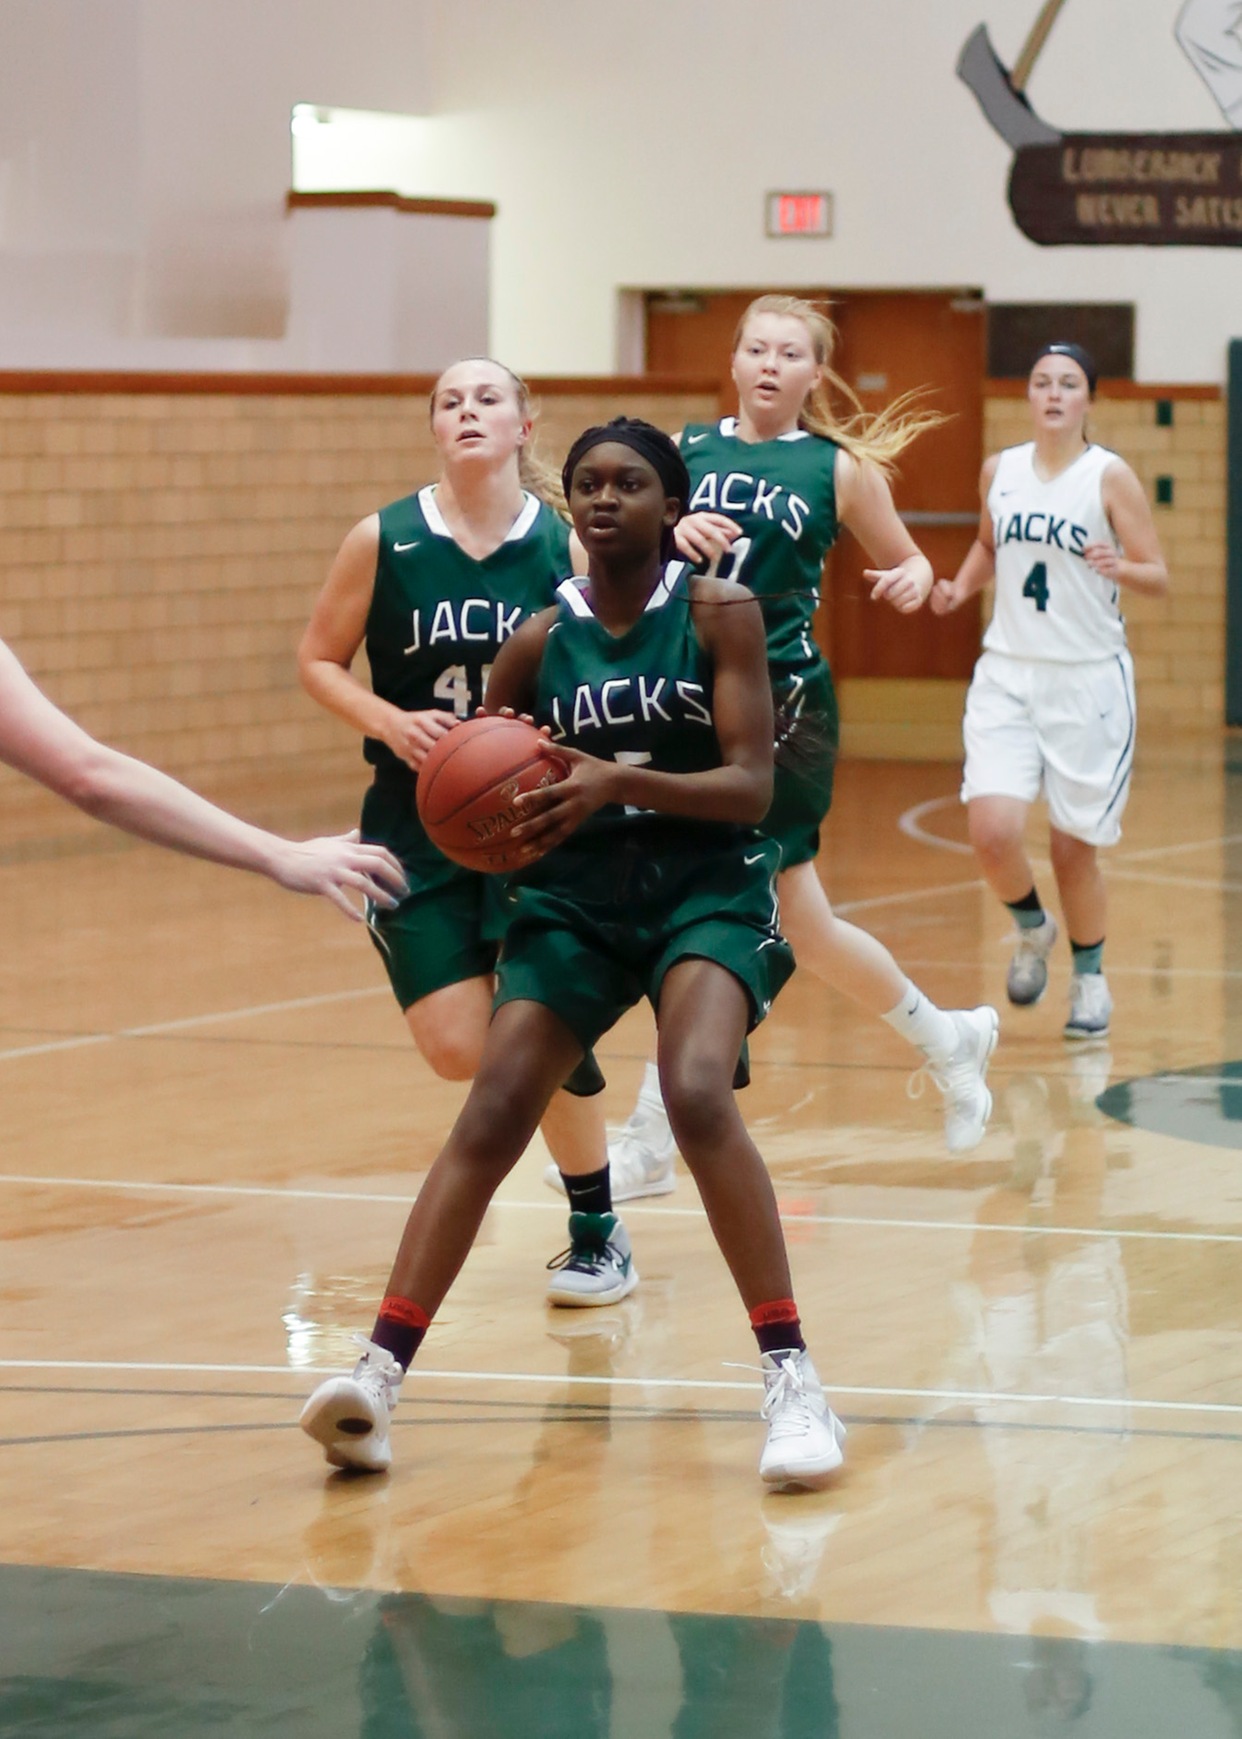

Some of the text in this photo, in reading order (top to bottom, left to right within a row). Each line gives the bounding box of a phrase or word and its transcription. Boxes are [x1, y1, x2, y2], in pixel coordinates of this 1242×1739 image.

[1075, 193, 1161, 226] NEVER
[689, 472, 810, 541] ACKS
[1022, 561, 1050, 612] 4
[403, 598, 535, 656] JACK
[433, 664, 494, 719] 4
[551, 675, 713, 741] JACKS
